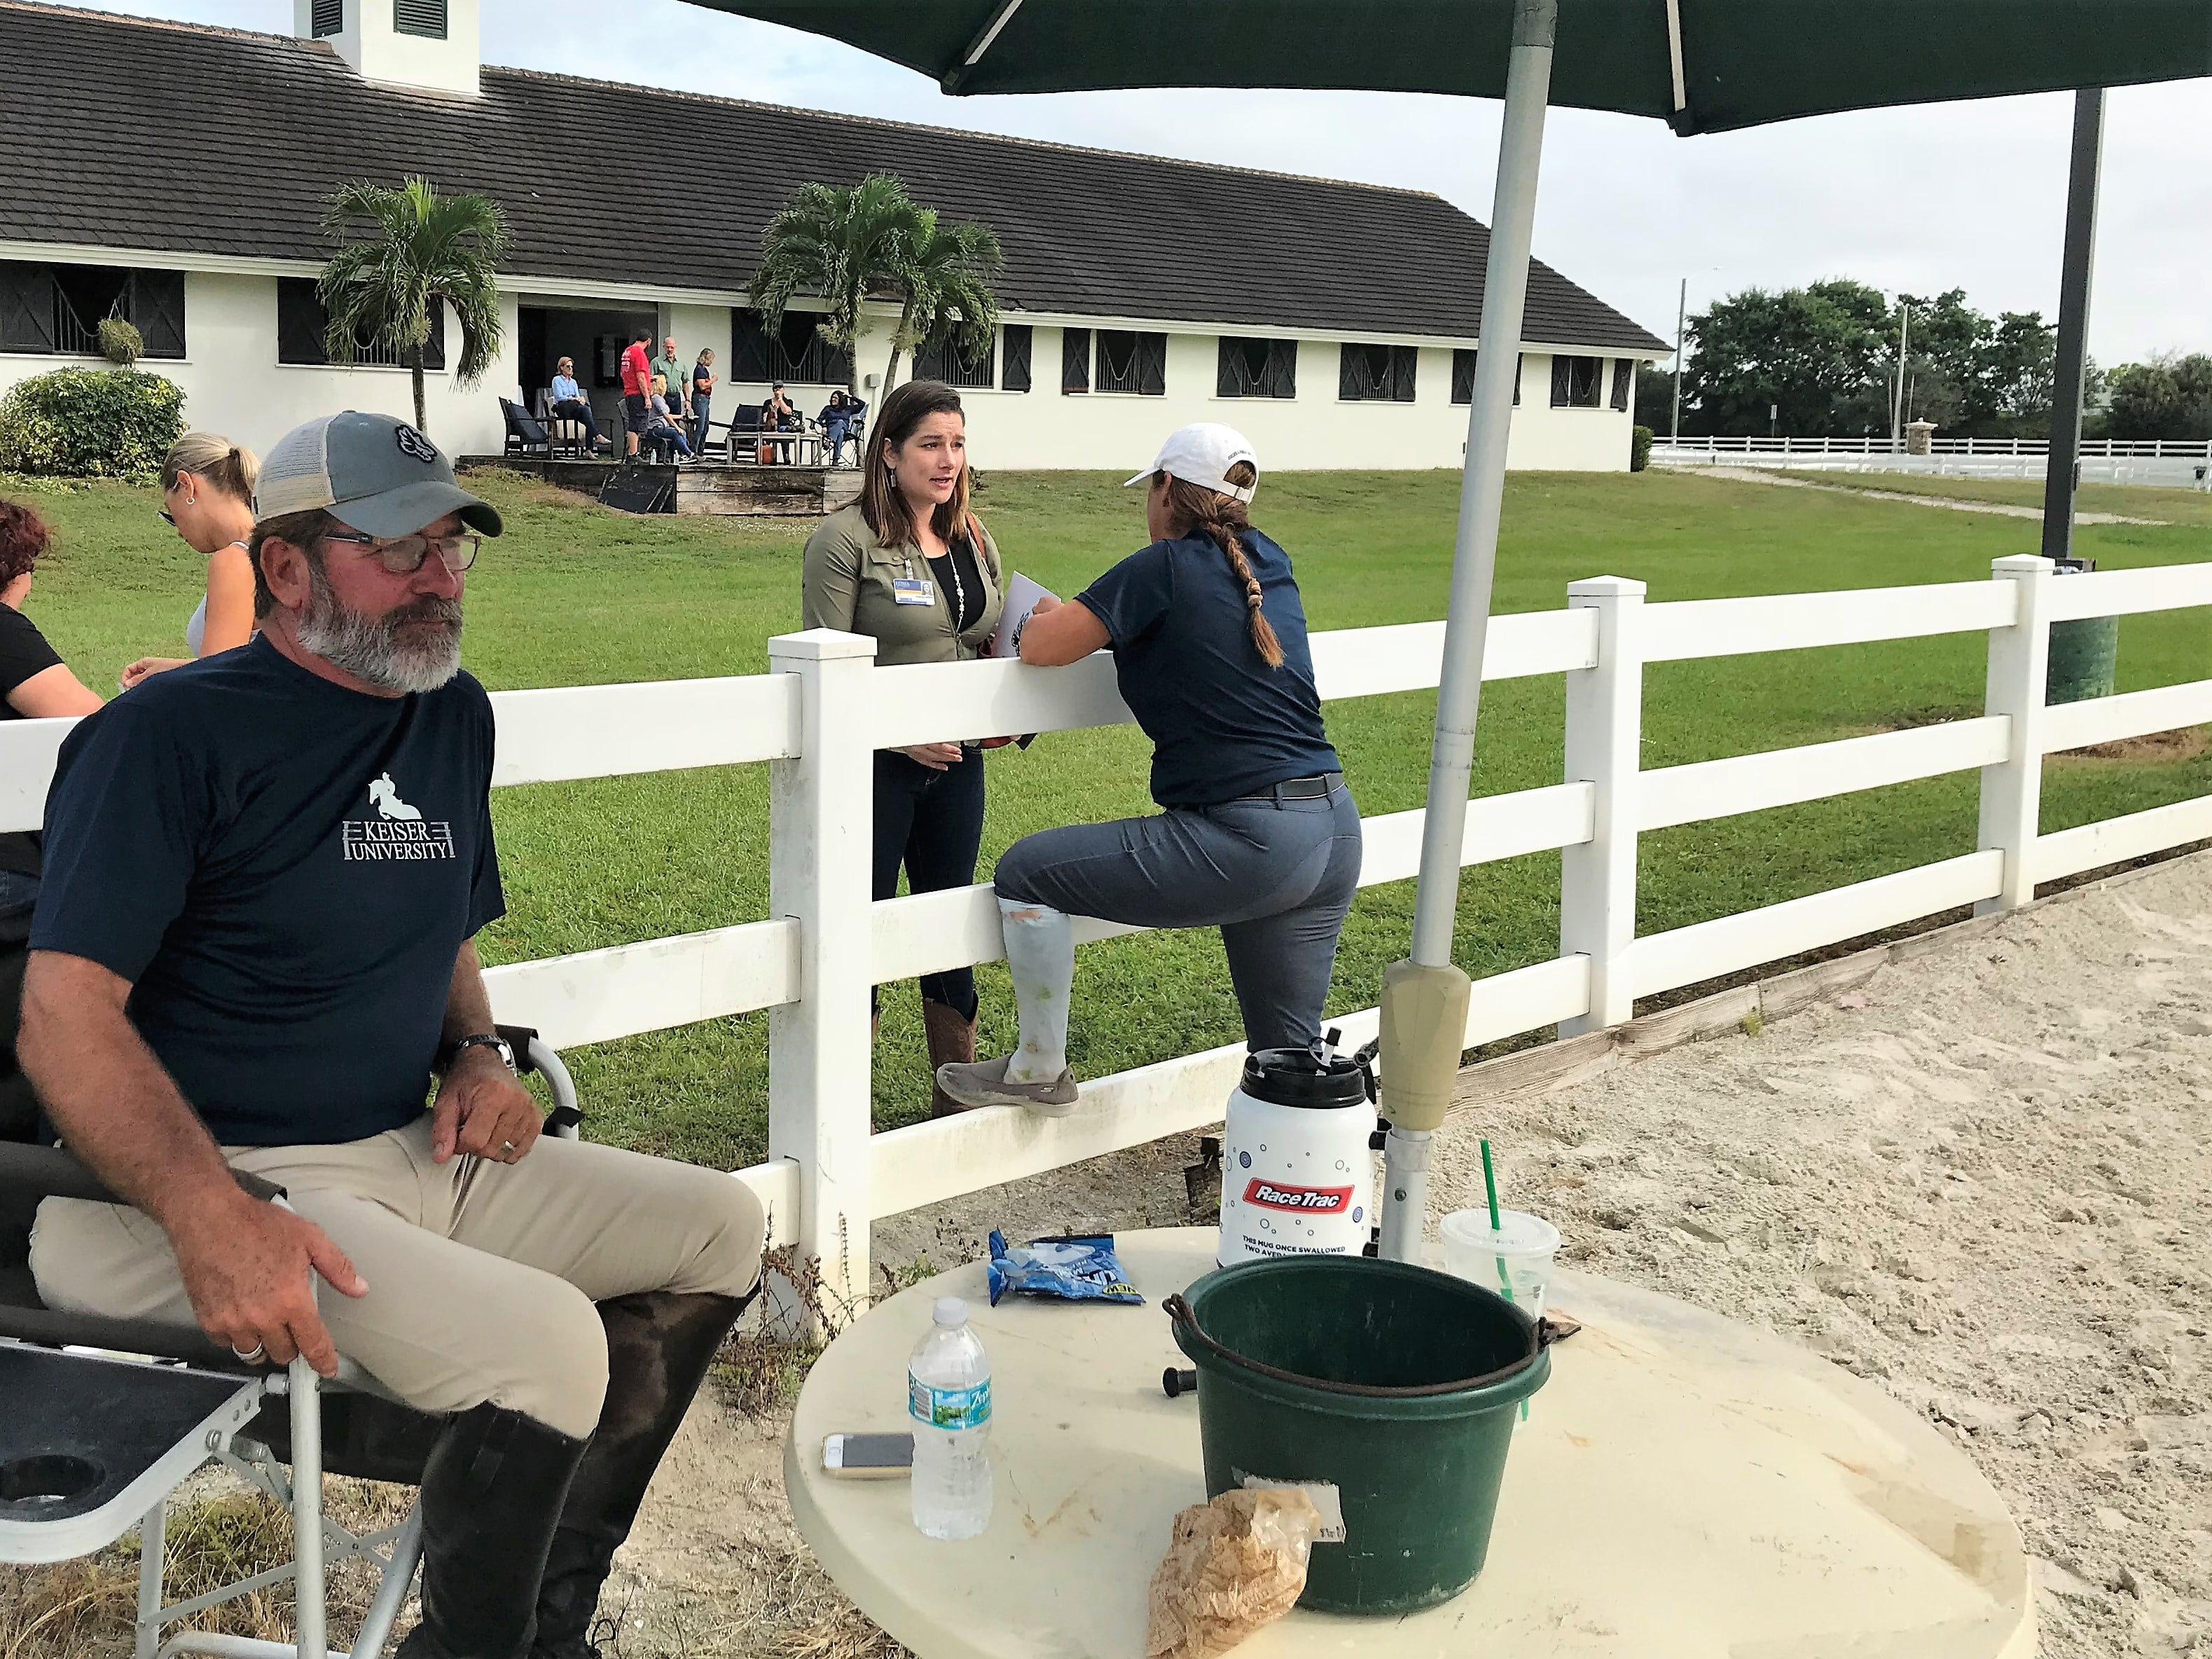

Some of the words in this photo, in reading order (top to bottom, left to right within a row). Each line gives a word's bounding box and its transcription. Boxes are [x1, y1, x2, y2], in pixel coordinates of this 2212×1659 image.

[364, 821, 431, 841] KEISER
[351, 842, 447, 860] UNIVERSITY
[1255, 1185, 1340, 1207] RaceTrac
[1243, 1234, 1257, 1244] THIS
[1257, 1239, 1274, 1248] MUG
[1275, 1244, 1297, 1253] ONCE
[1299, 1246, 1346, 1254] SWALLOWED
[1245, 1244, 1260, 1253] TWO
